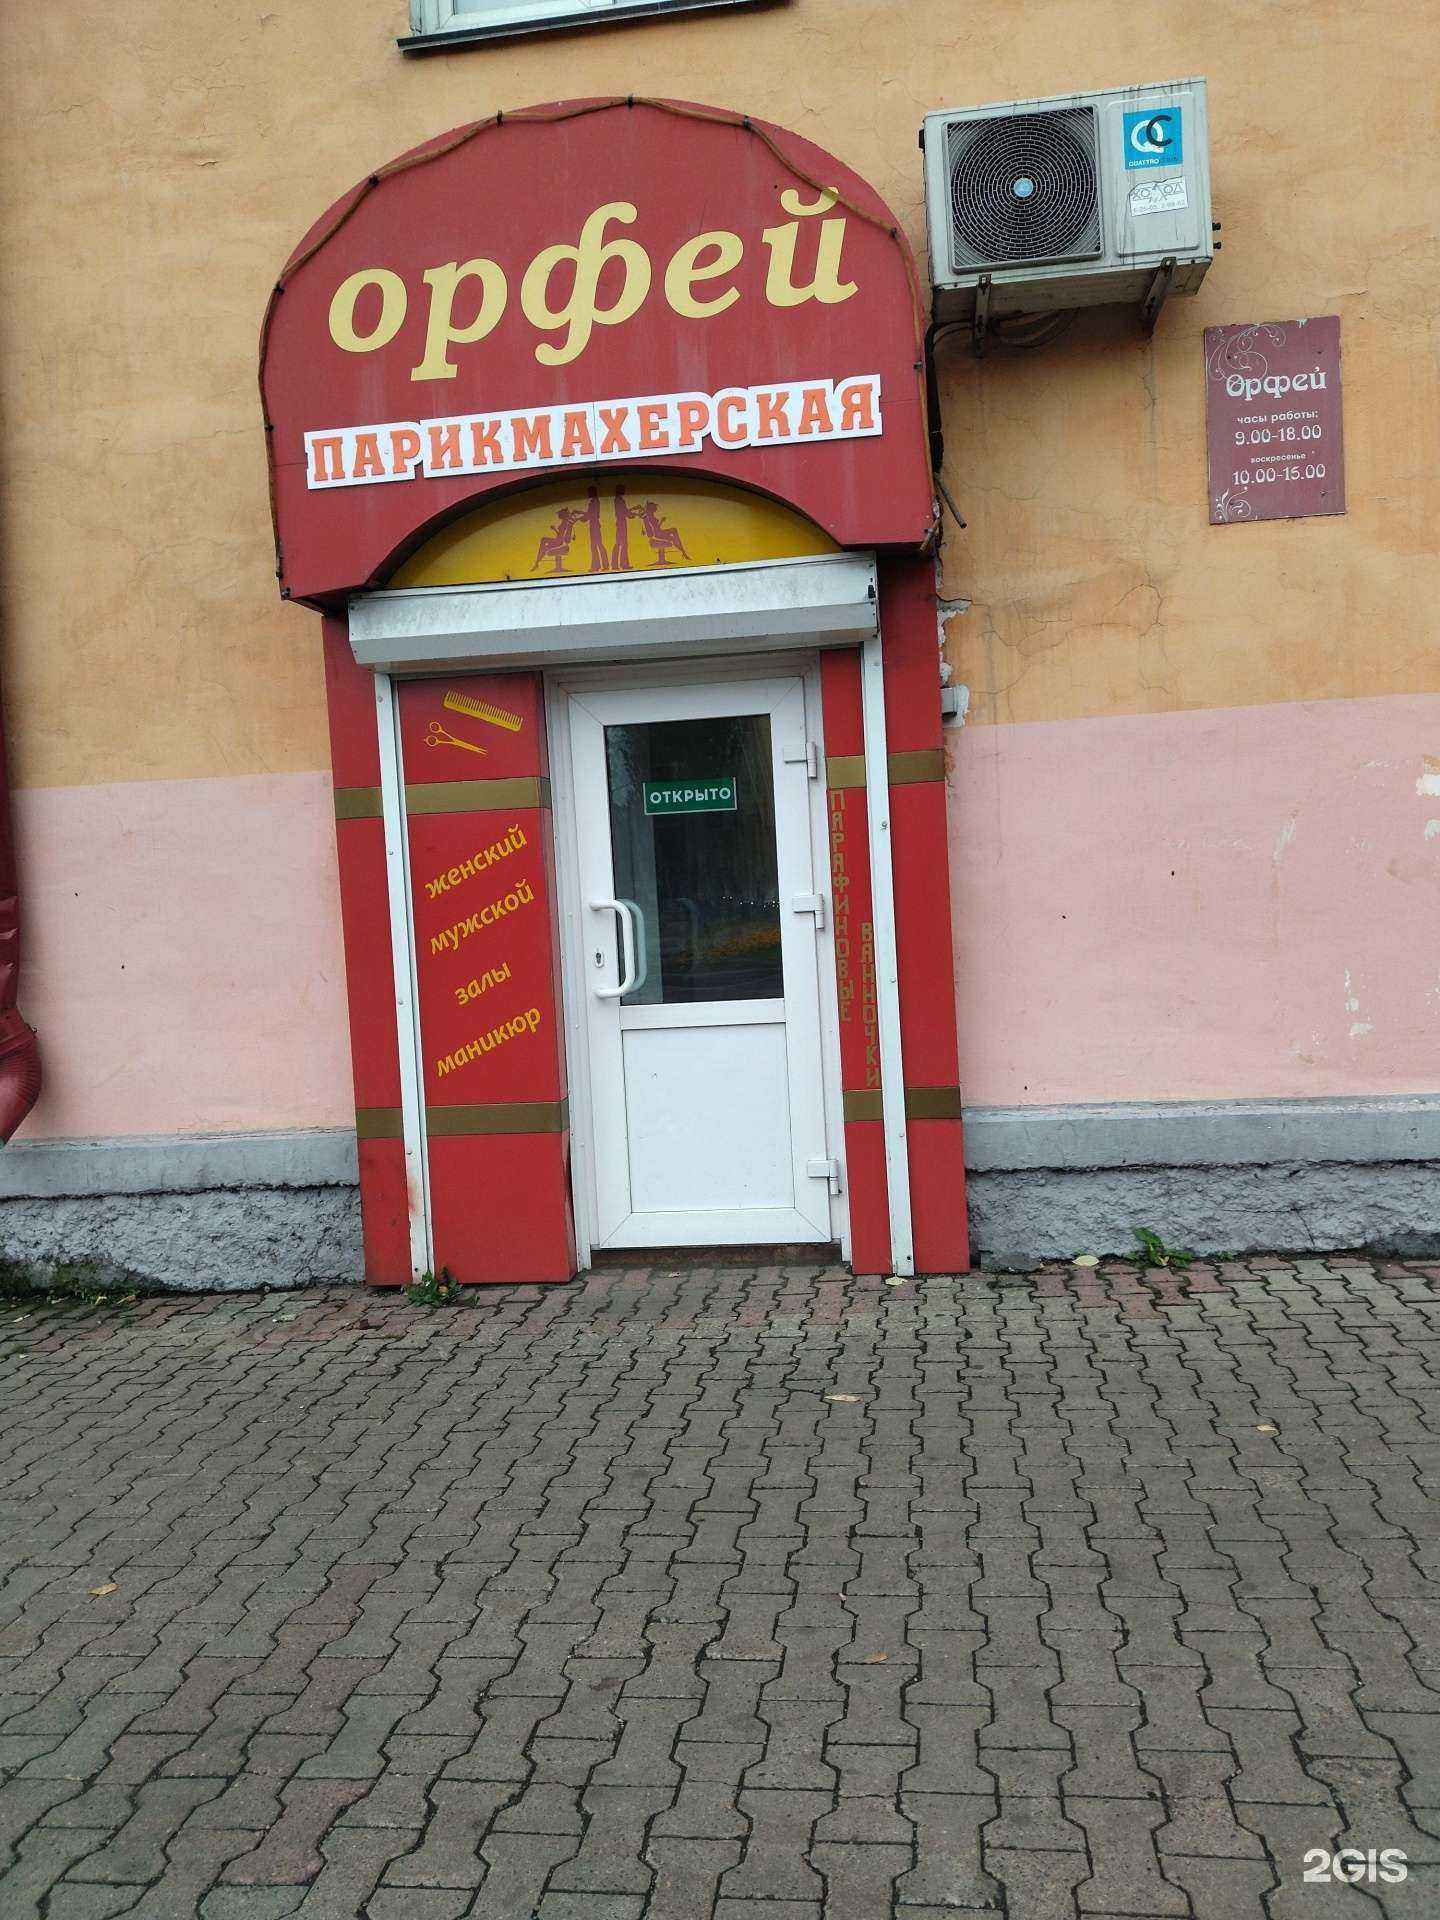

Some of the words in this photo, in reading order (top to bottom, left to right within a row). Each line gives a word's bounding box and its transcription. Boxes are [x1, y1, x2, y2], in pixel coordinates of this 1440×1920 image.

[328, 186, 859, 382] орфей
[1226, 366, 1327, 401] Орфей
[1237, 415, 1267, 424] часы
[1271, 410, 1318, 423] работы:
[311, 383, 876, 482] ПАРИКМАХЕРСКАЯ
[1235, 424, 1321, 445] 9.00-18.00
[650, 787, 731, 804] ОТКРЫТО
[425, 823, 528, 899] женский
[430, 878, 535, 955] мужской
[831, 788, 855, 1022] ПАРАФИНОВЫЕ
[454, 962, 512, 1005] залы
[861, 922, 881, 1088] ВАННОЧКИ
[436, 1007, 542, 1077] маникюр
